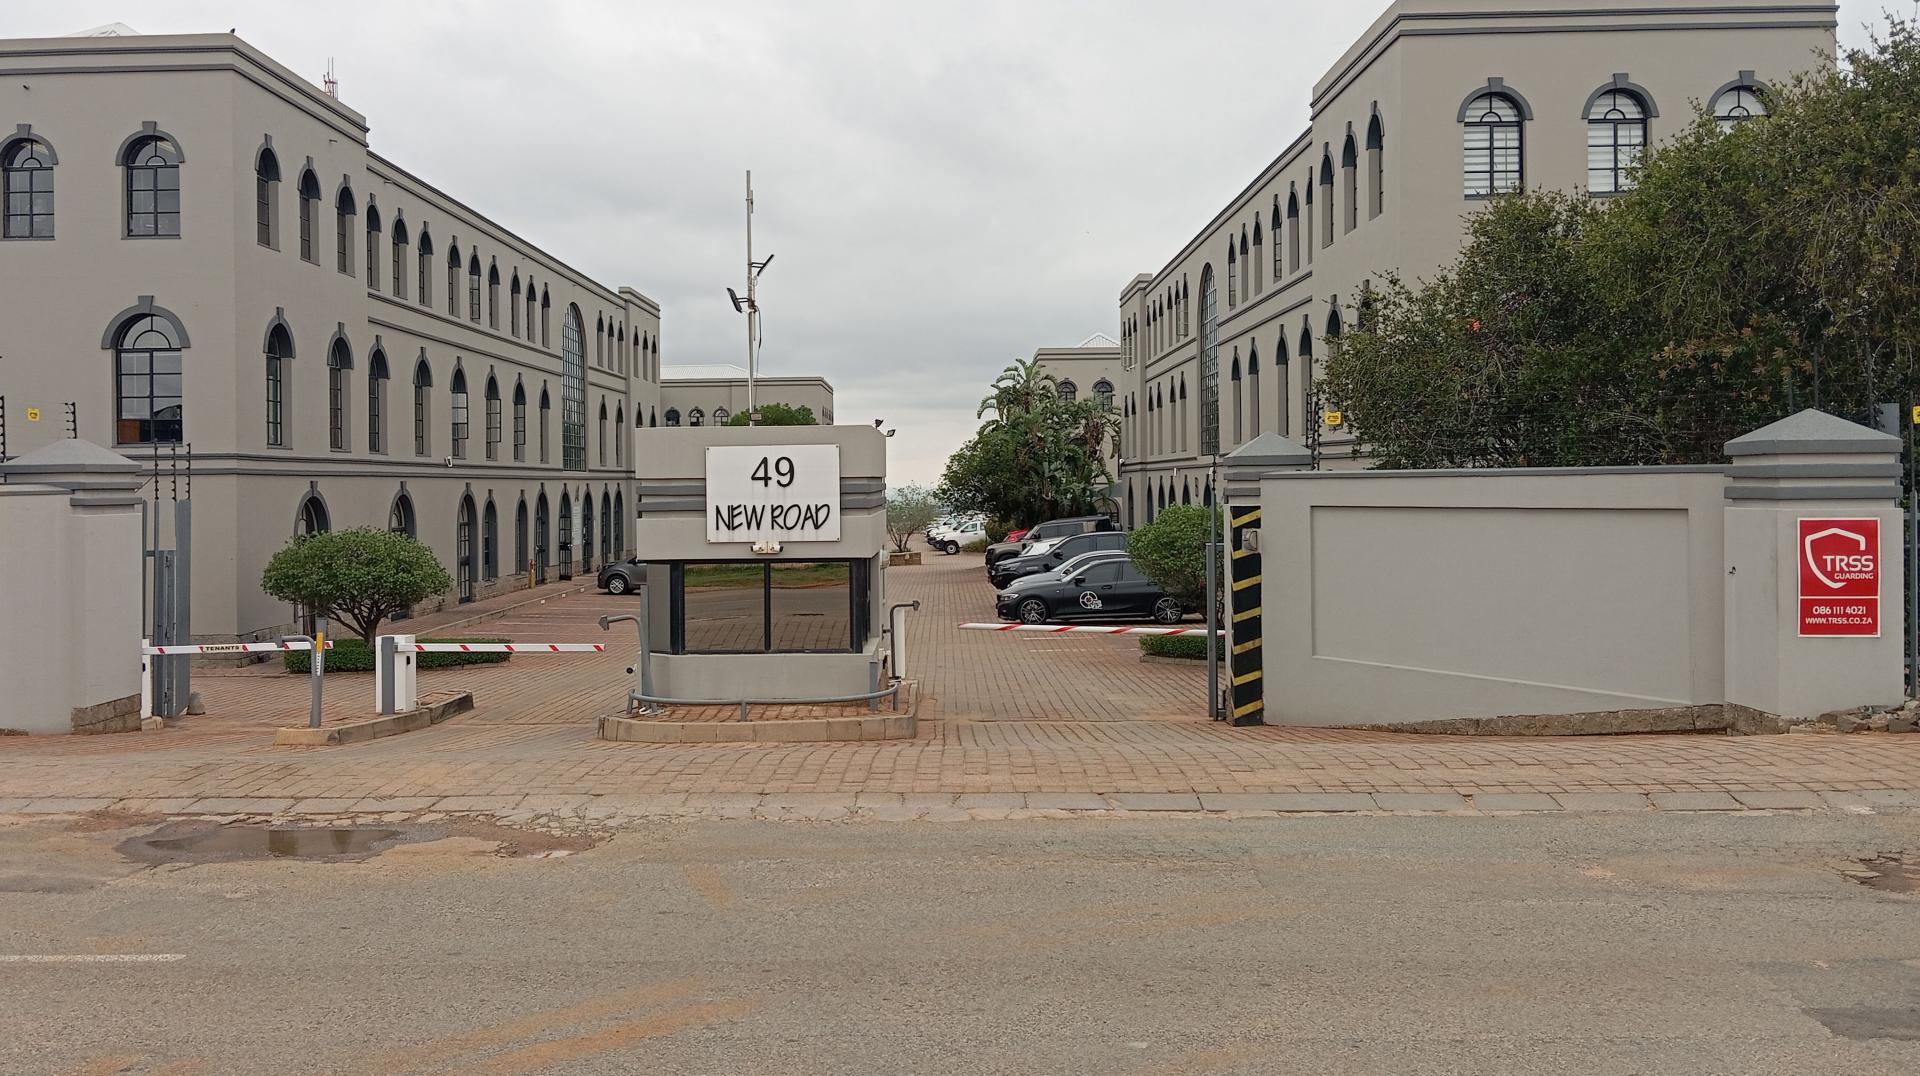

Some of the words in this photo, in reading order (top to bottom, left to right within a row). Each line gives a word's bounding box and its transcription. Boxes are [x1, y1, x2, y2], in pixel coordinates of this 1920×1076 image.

[751, 456, 795, 488] 49
[715, 504, 766, 531] NEW
[770, 503, 831, 531] ROAD
[1822, 555, 1874, 572] TRSS
[1834, 572, 1874, 580] GUARDING
[1812, 606, 1832, 615] 086
[1833, 606, 1844, 615] 111
[1845, 606, 1867, 615] 4021
[1805, 617, 1873, 625] WWW.TRSS.CO.ZA
